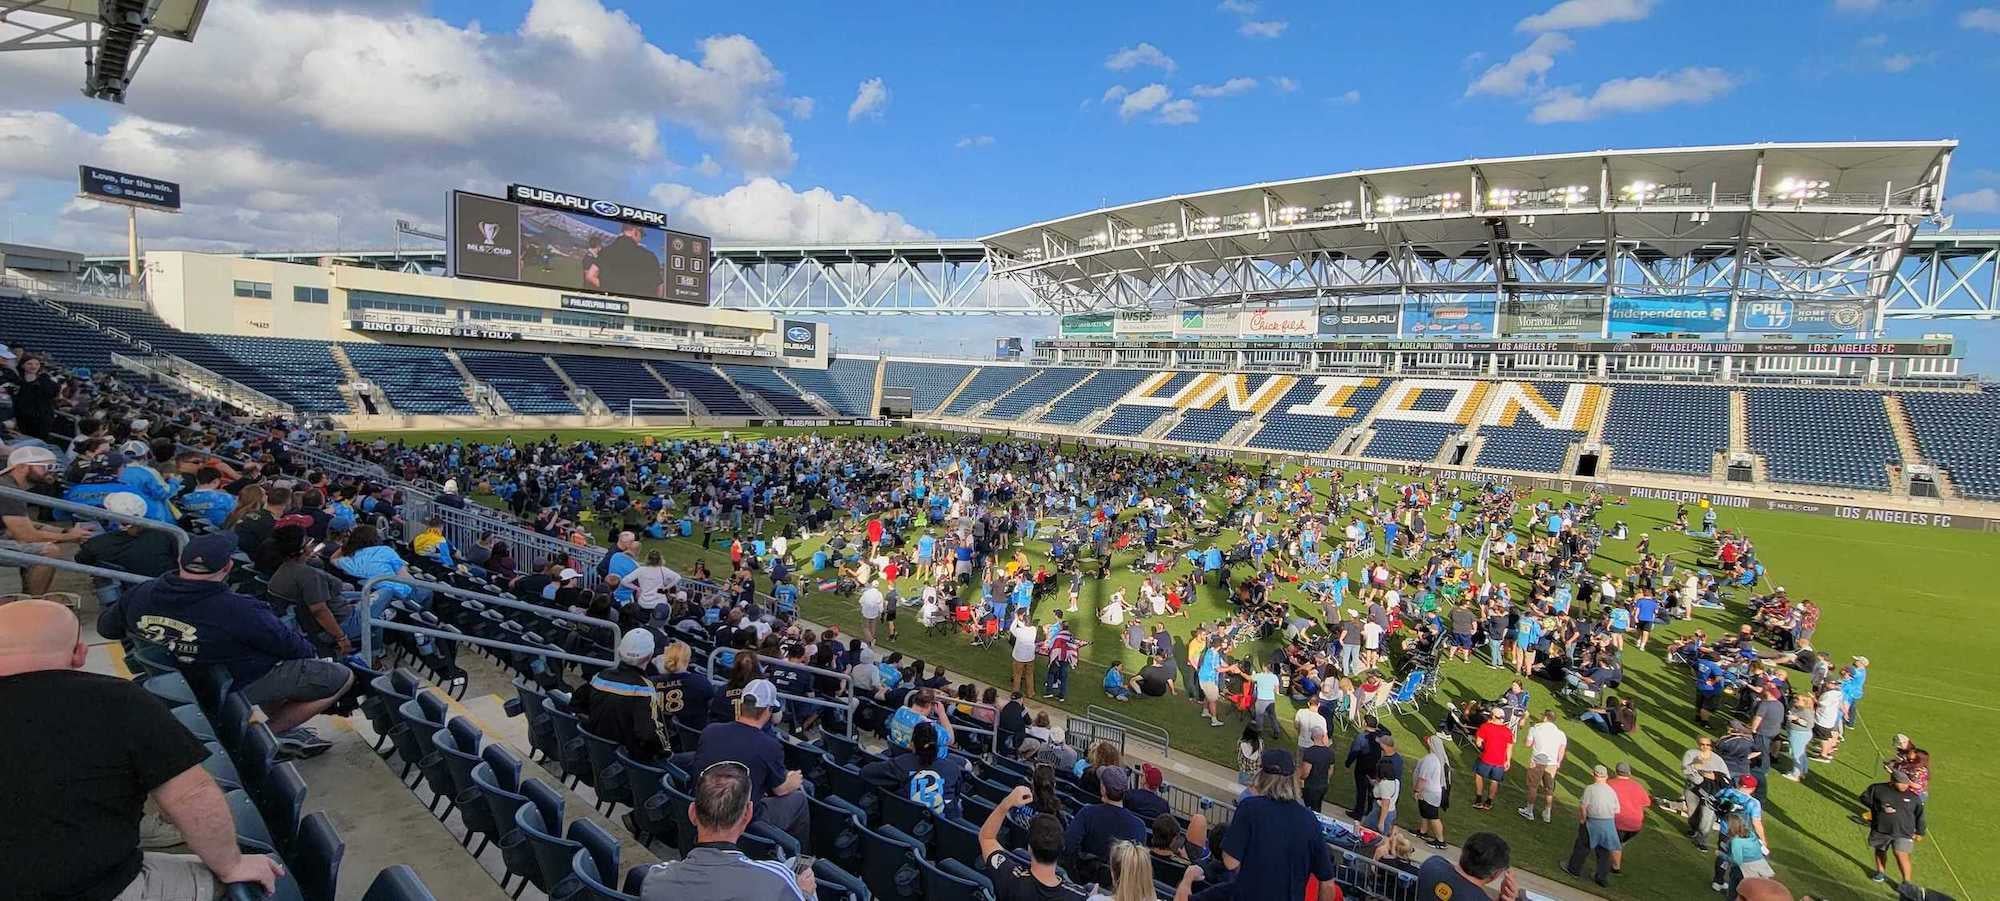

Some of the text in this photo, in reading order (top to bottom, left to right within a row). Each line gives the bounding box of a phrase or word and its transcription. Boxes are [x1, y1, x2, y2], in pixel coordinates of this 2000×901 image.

[92, 171, 173, 193] Love, for the win.
[124, 189, 165, 201] SUBARU
[517, 187, 666, 225] SUBARU PARK
[466, 243, 512, 255] MLS CUP
[1613, 308, 1708, 320] Independence
[1751, 303, 1787, 316] PHL
[1122, 311, 1152, 321] WSFS
[1341, 315, 1397, 324] SUBARU
[1768, 315, 1787, 327] 17
[362, 321, 513, 340] RING OF HONOR LE TOUX
[784, 342, 815, 351] SUBARU
[1387, 342, 1454, 350] PHILADELPHIA UNION
[1497, 343, 1558, 351] LOS ANGELES FC
[1650, 343, 1745, 353] PHILADELPHIA UNION
[1808, 344, 1895, 354] LOS ANGELES FC
[1117, 370, 1605, 431] UNION
[1184, 446, 1198, 455] LOS
[1225, 450, 1234, 458] FC
[1363, 463, 1388, 473] UNION
[1440, 470, 1513, 485] LOS ANGELES FC
[1713, 495, 1750, 508] UNION
[1777, 503, 1794, 511] MLS
[1834, 506, 1951, 528] LOS ANGELES FC
